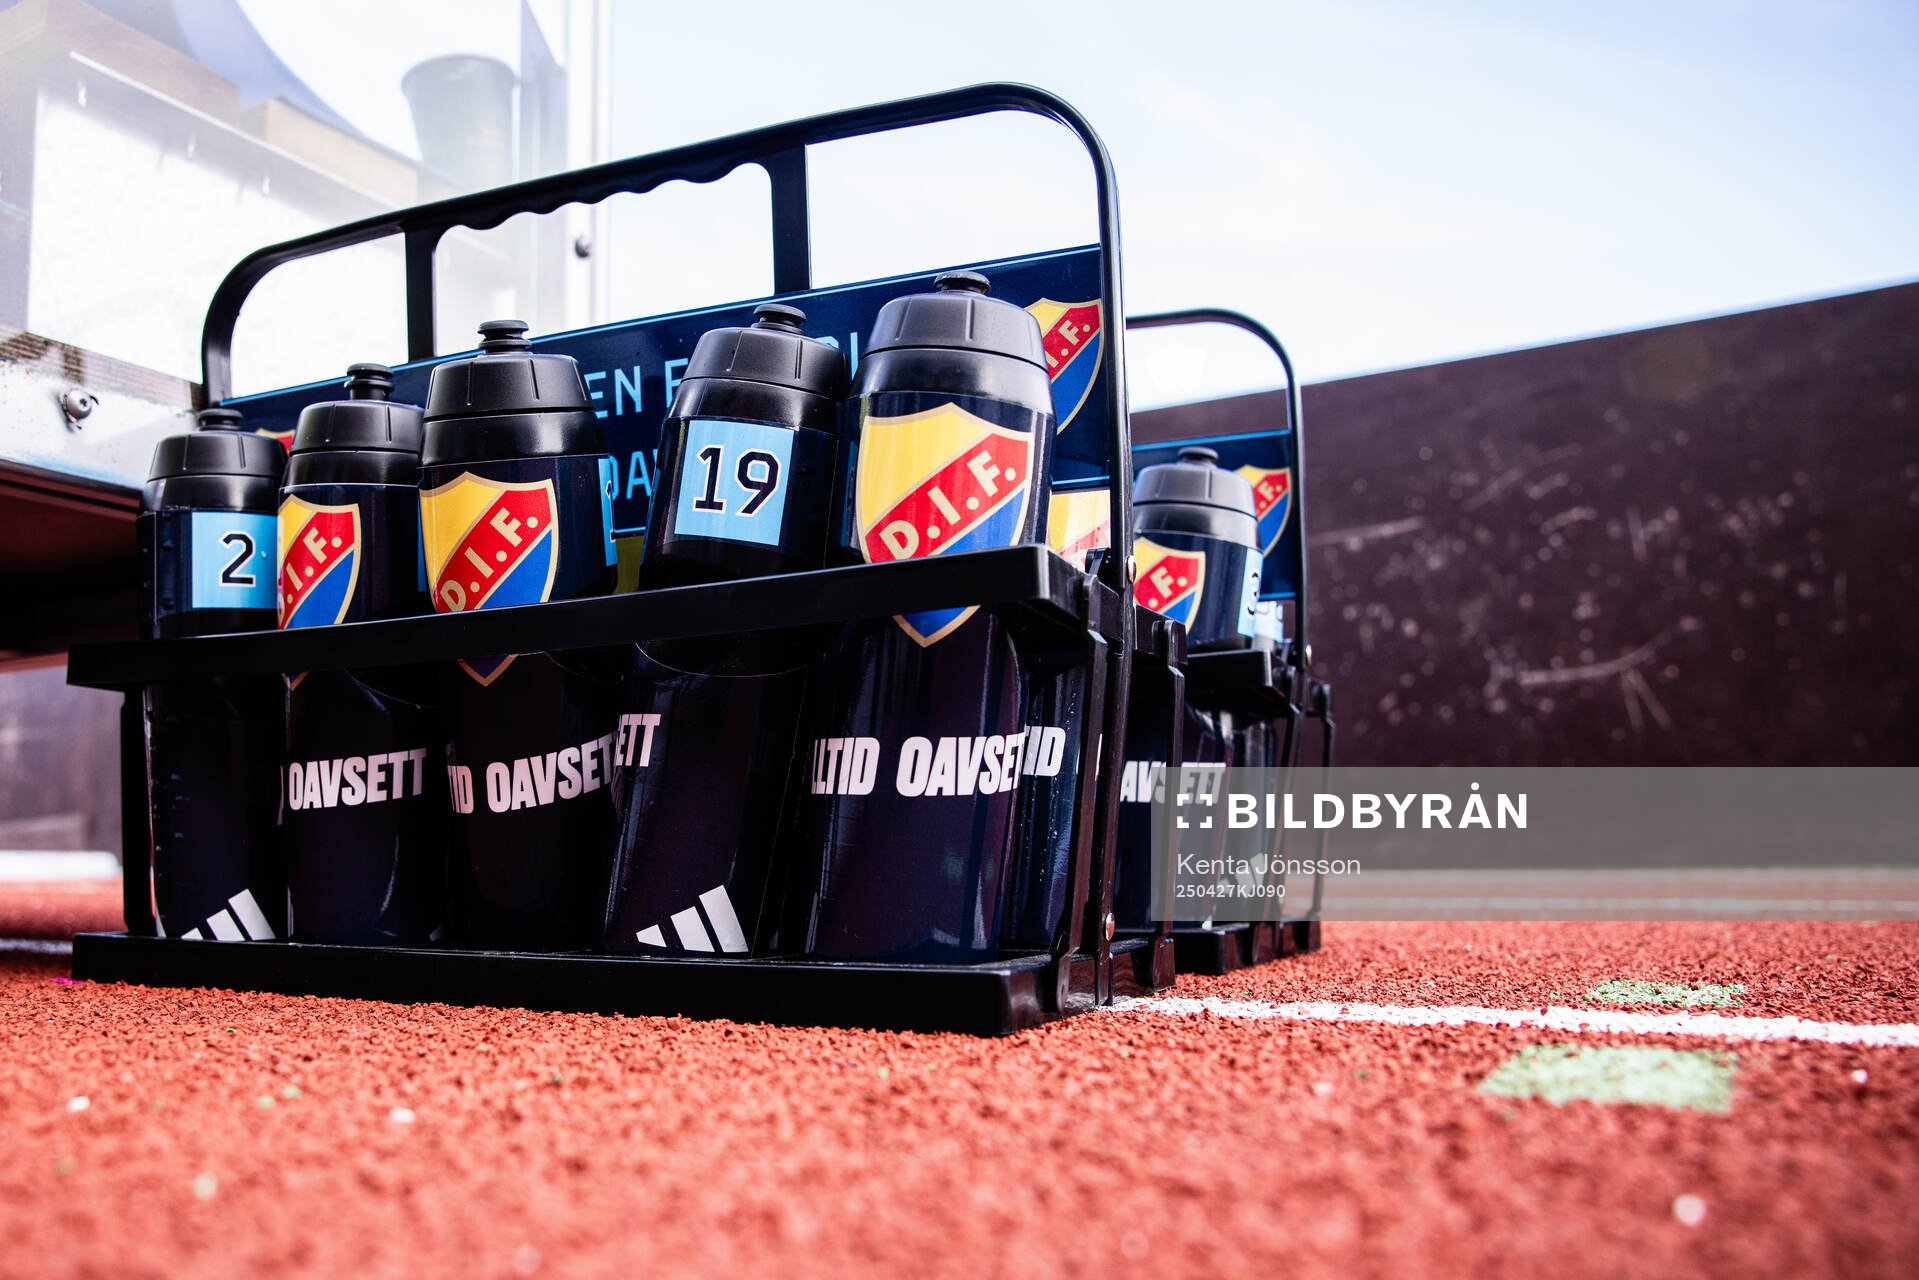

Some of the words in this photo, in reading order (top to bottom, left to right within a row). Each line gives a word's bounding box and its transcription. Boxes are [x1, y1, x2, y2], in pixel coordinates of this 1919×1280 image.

[692, 443, 781, 517] 19
[217, 529, 257, 588] 2
[288, 747, 427, 811] OAVSETT
